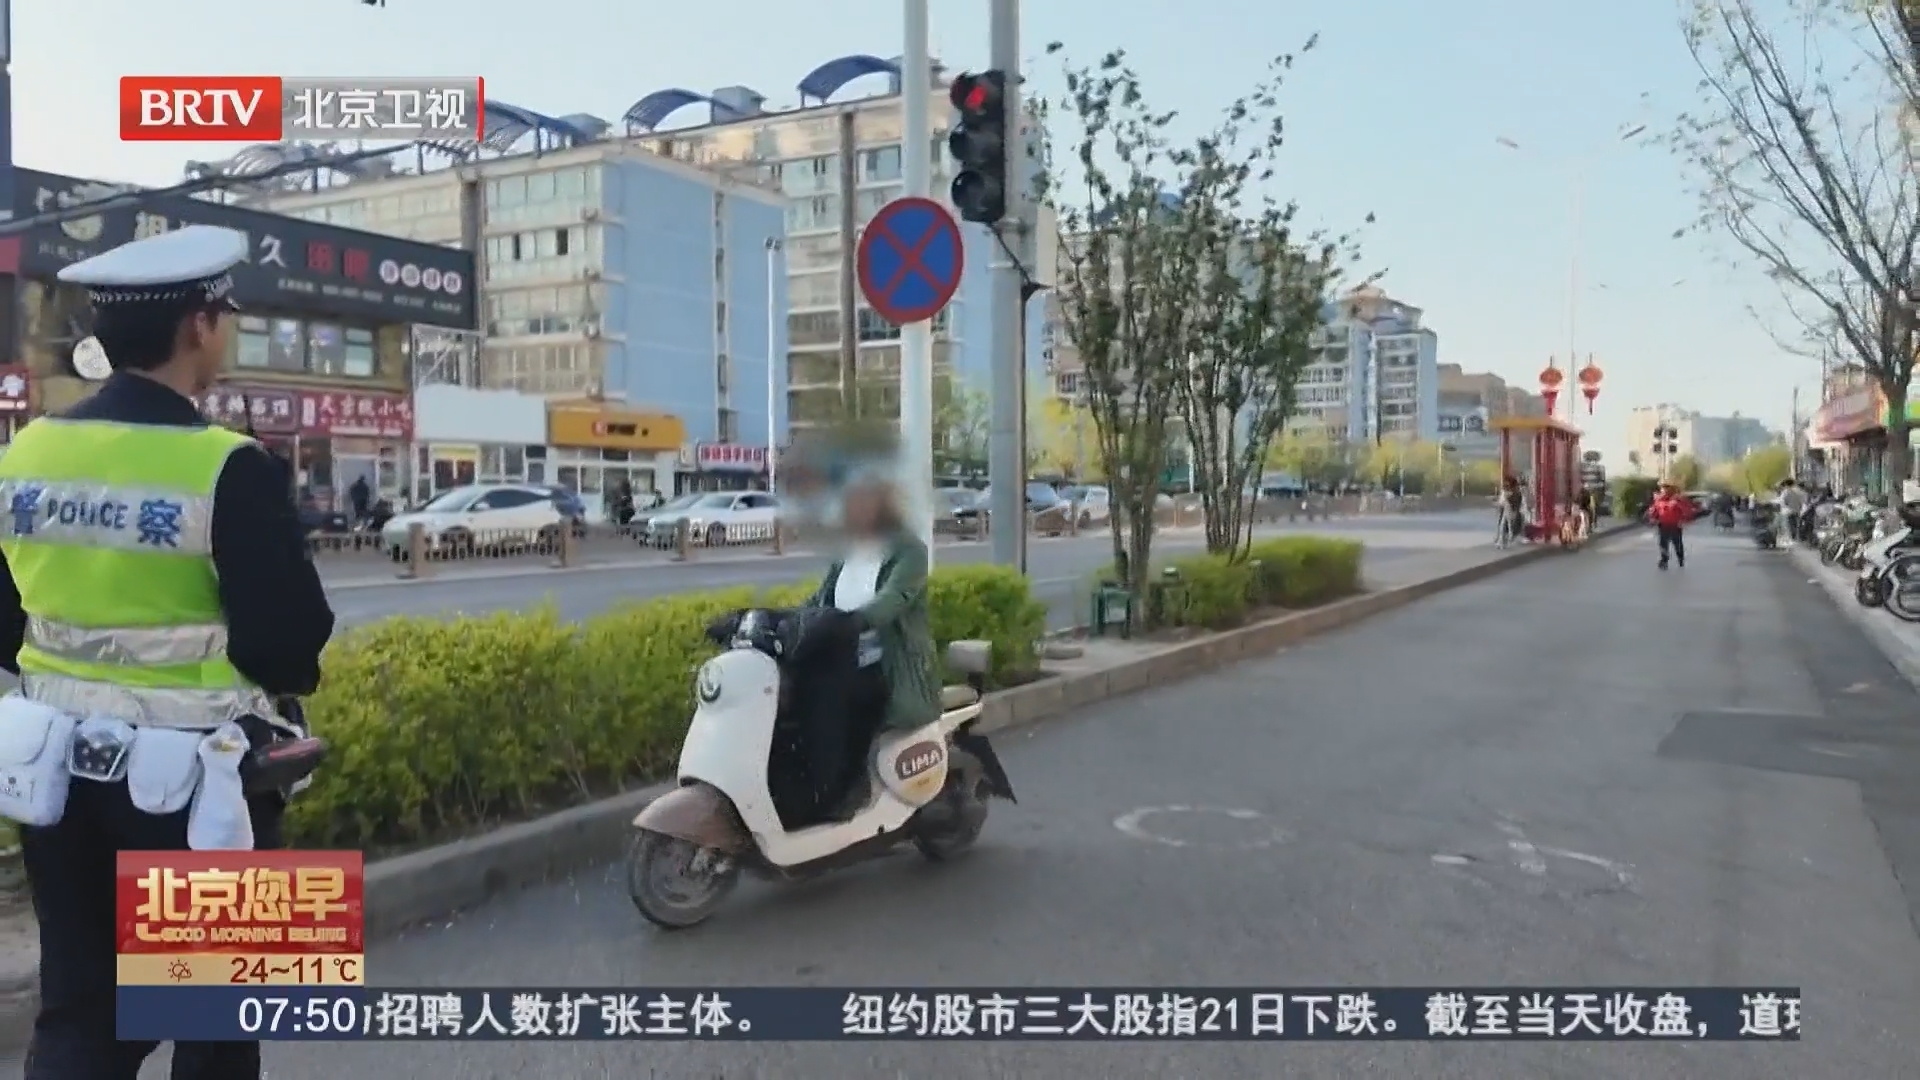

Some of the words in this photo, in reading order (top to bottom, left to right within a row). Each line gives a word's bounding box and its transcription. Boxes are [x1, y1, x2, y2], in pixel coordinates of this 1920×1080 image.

[47, 498, 130, 530] POLICE
[137, 499, 183, 548] 察
[902, 749, 941, 776] LIMA
